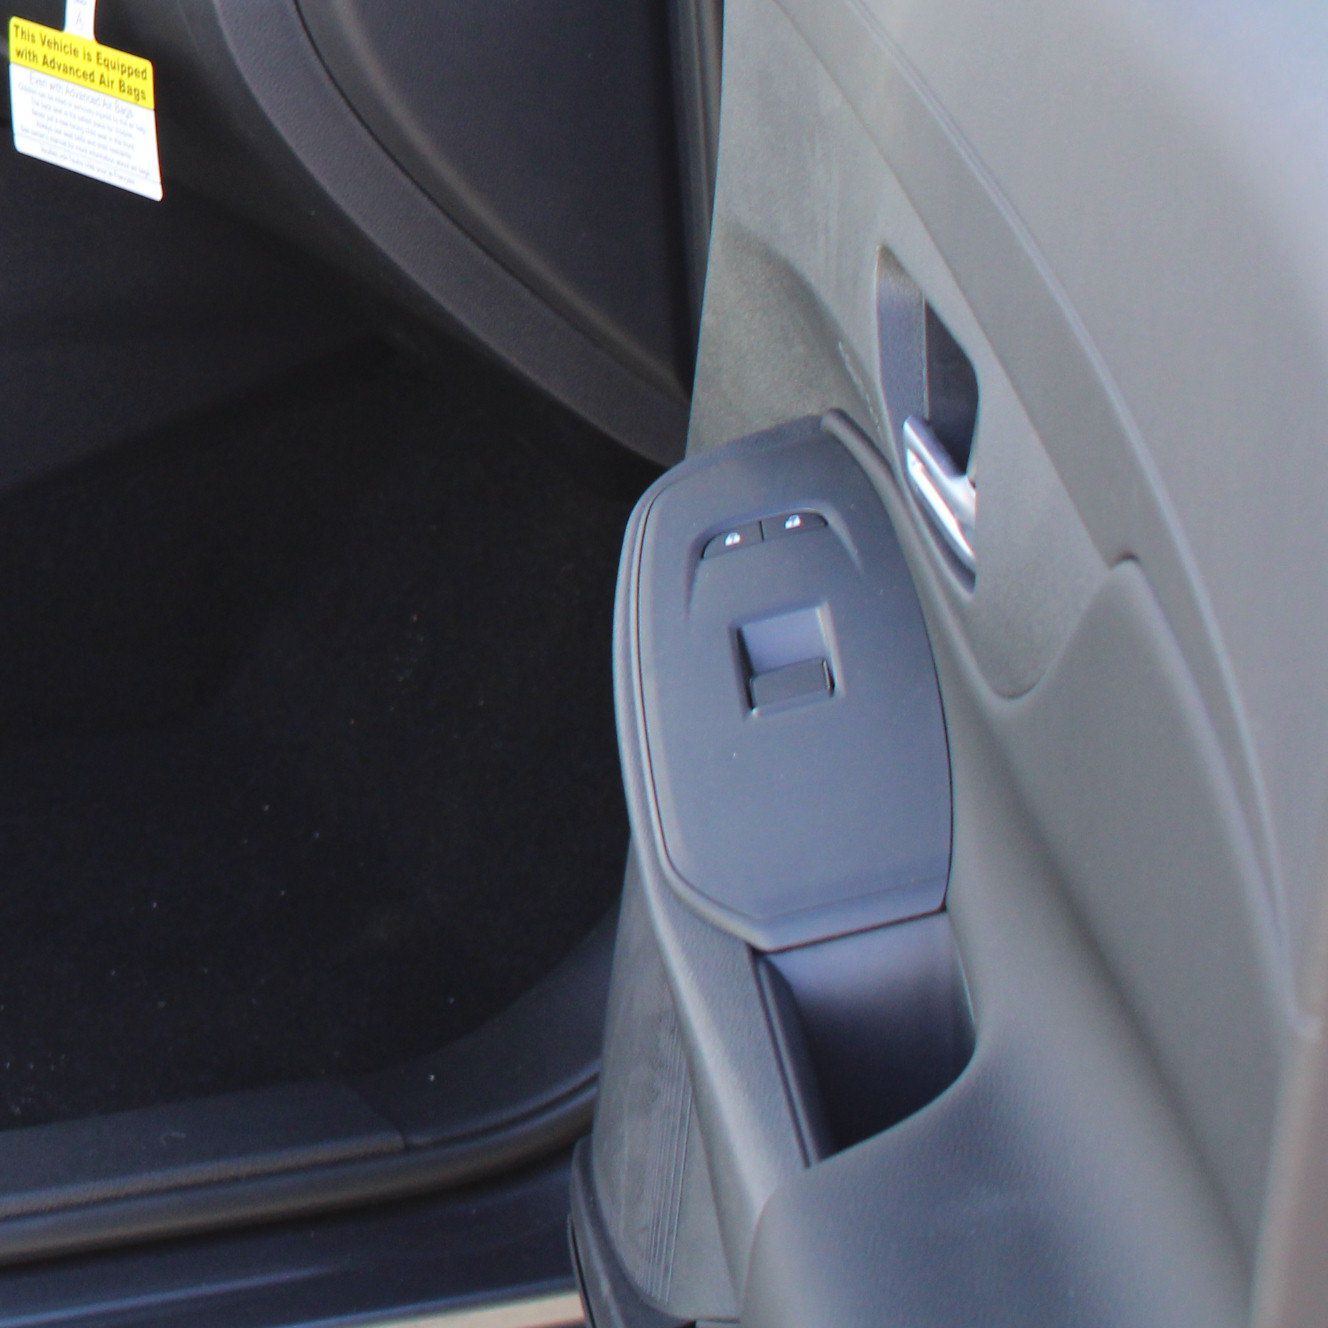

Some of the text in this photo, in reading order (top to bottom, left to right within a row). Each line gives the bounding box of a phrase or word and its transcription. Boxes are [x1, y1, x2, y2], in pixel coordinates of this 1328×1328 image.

[14, 24, 147, 80] This Vehicle is Equipped
[16, 48, 146, 102] with Advanced Air Bags
